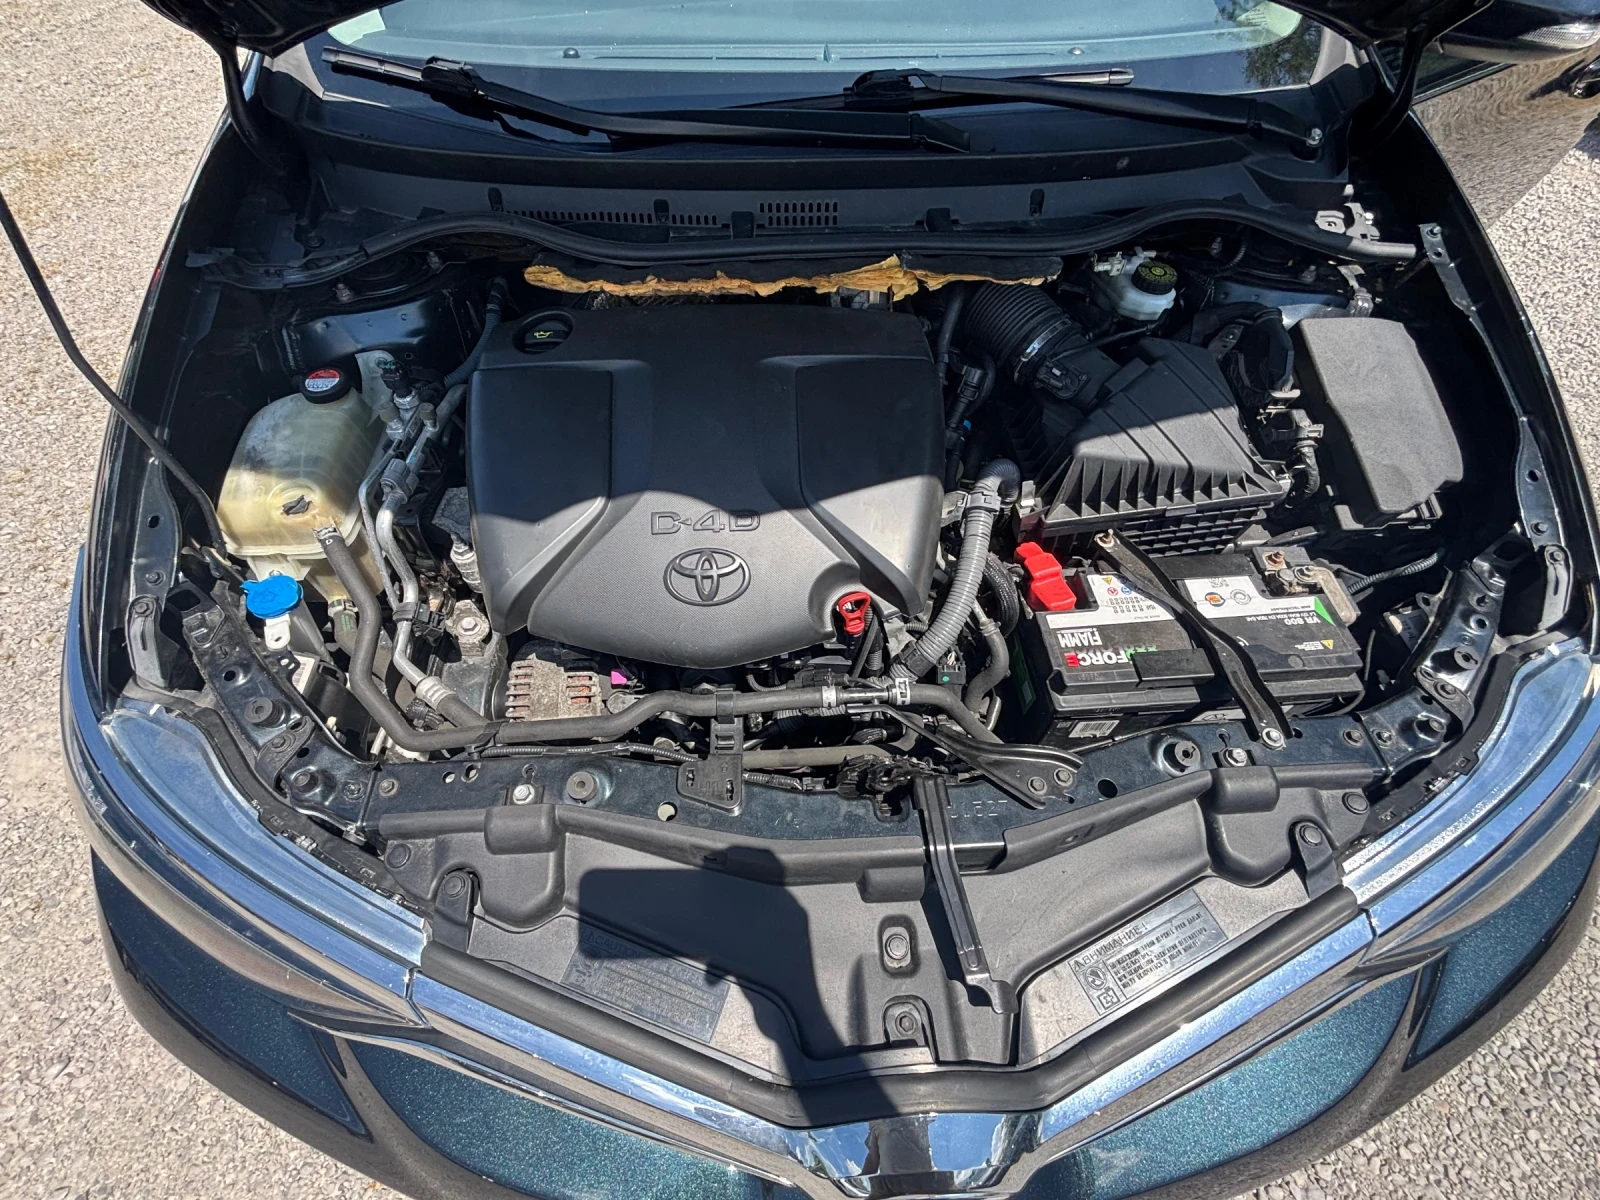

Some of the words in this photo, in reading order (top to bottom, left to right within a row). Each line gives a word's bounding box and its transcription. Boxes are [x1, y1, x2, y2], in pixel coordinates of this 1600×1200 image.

[650, 509, 761, 536] D-4D
[1284, 618, 1304, 626] 800
[1305, 616, 1321, 624] VR
[1057, 629, 1103, 649] FIAMM
[594, 935, 641, 959] CAUTION
